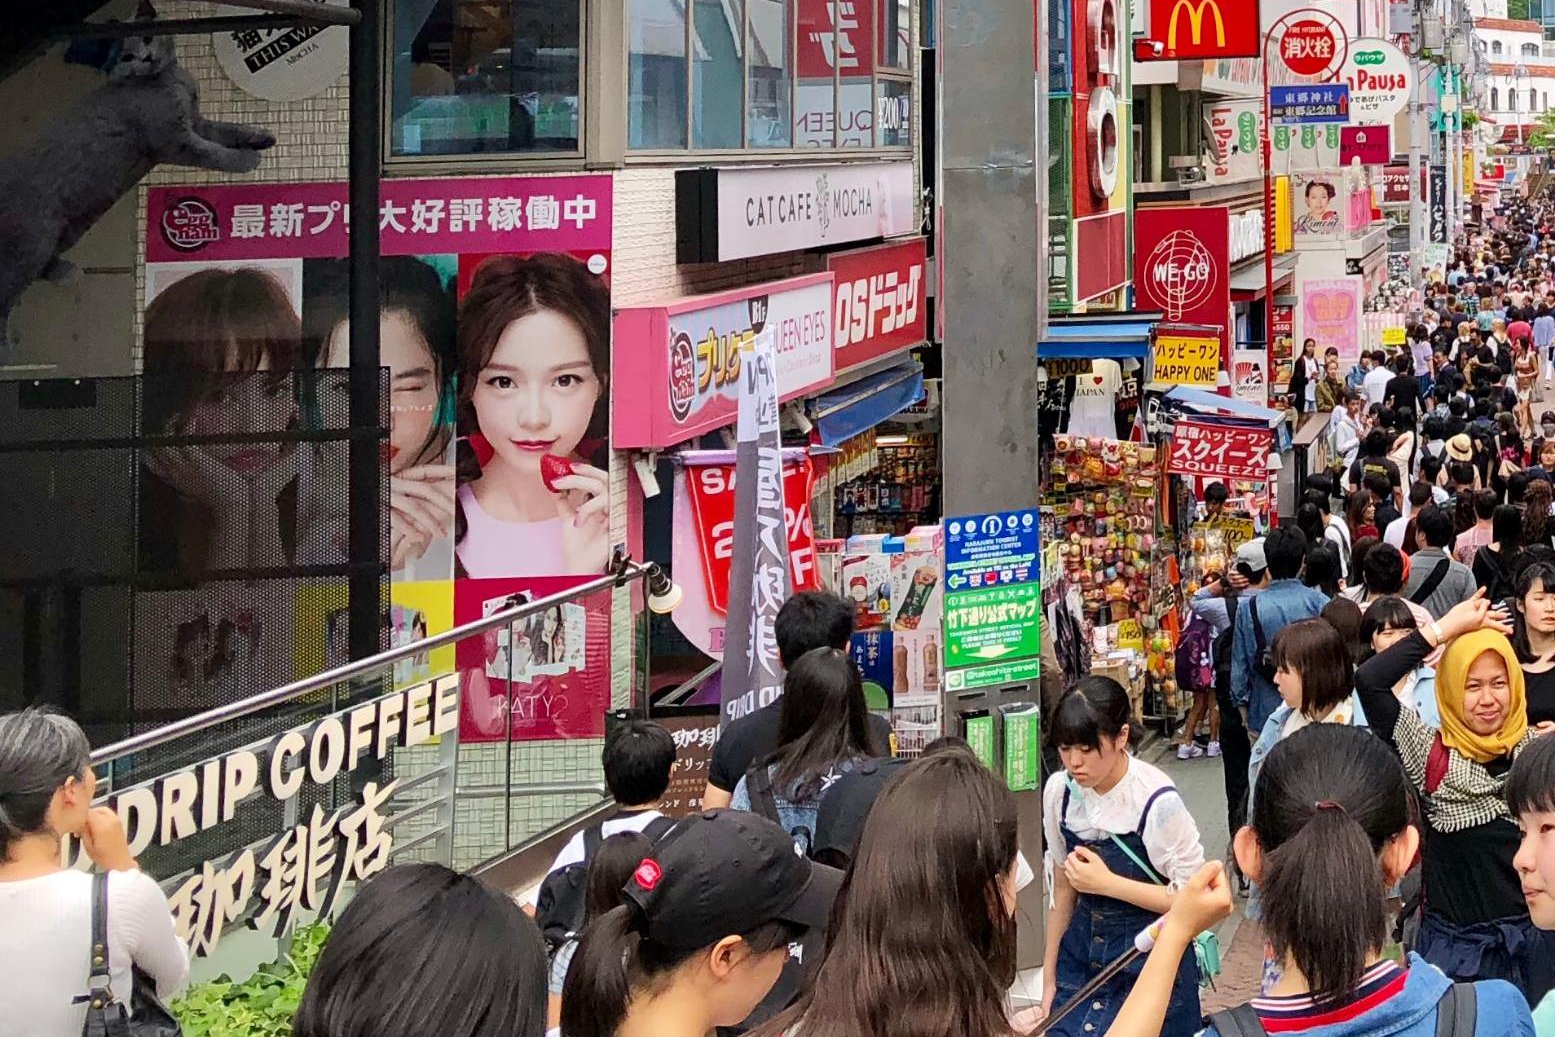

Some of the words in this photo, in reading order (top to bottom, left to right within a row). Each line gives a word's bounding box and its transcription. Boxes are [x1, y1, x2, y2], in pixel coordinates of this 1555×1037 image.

[250, 37, 291, 69] THIS
[1284, 36, 1332, 60] 消火栓
[1357, 69, 1406, 92] Pausa
[1285, 92, 1334, 103] 東郷神社
[745, 195, 775, 228] CAT
[778, 191, 812, 224] CAFE
[833, 187, 873, 220] MOCHA
[835, 264, 922, 349] OSドラッグ
[773, 318, 801, 355] UEEN
[803, 310, 826, 346] EYES
[1156, 343, 1218, 361] ハッピーワン
[1154, 365, 1190, 382] HAPPY
[1193, 365, 1217, 382] ONE
[1076, 388, 1106, 397] JAPAN
[1175, 423, 1272, 445] 原宿ハッピーワン
[1172, 437, 1270, 467] スクイーズ
[1171, 459, 1268, 478] SQUEEZE
[946, 598, 1037, 630] 竹下通り公式マップ
[115, 750, 258, 860] DRIP
[270, 671, 460, 801] COFFEE
[170, 778, 400, 958] 珈琲店
